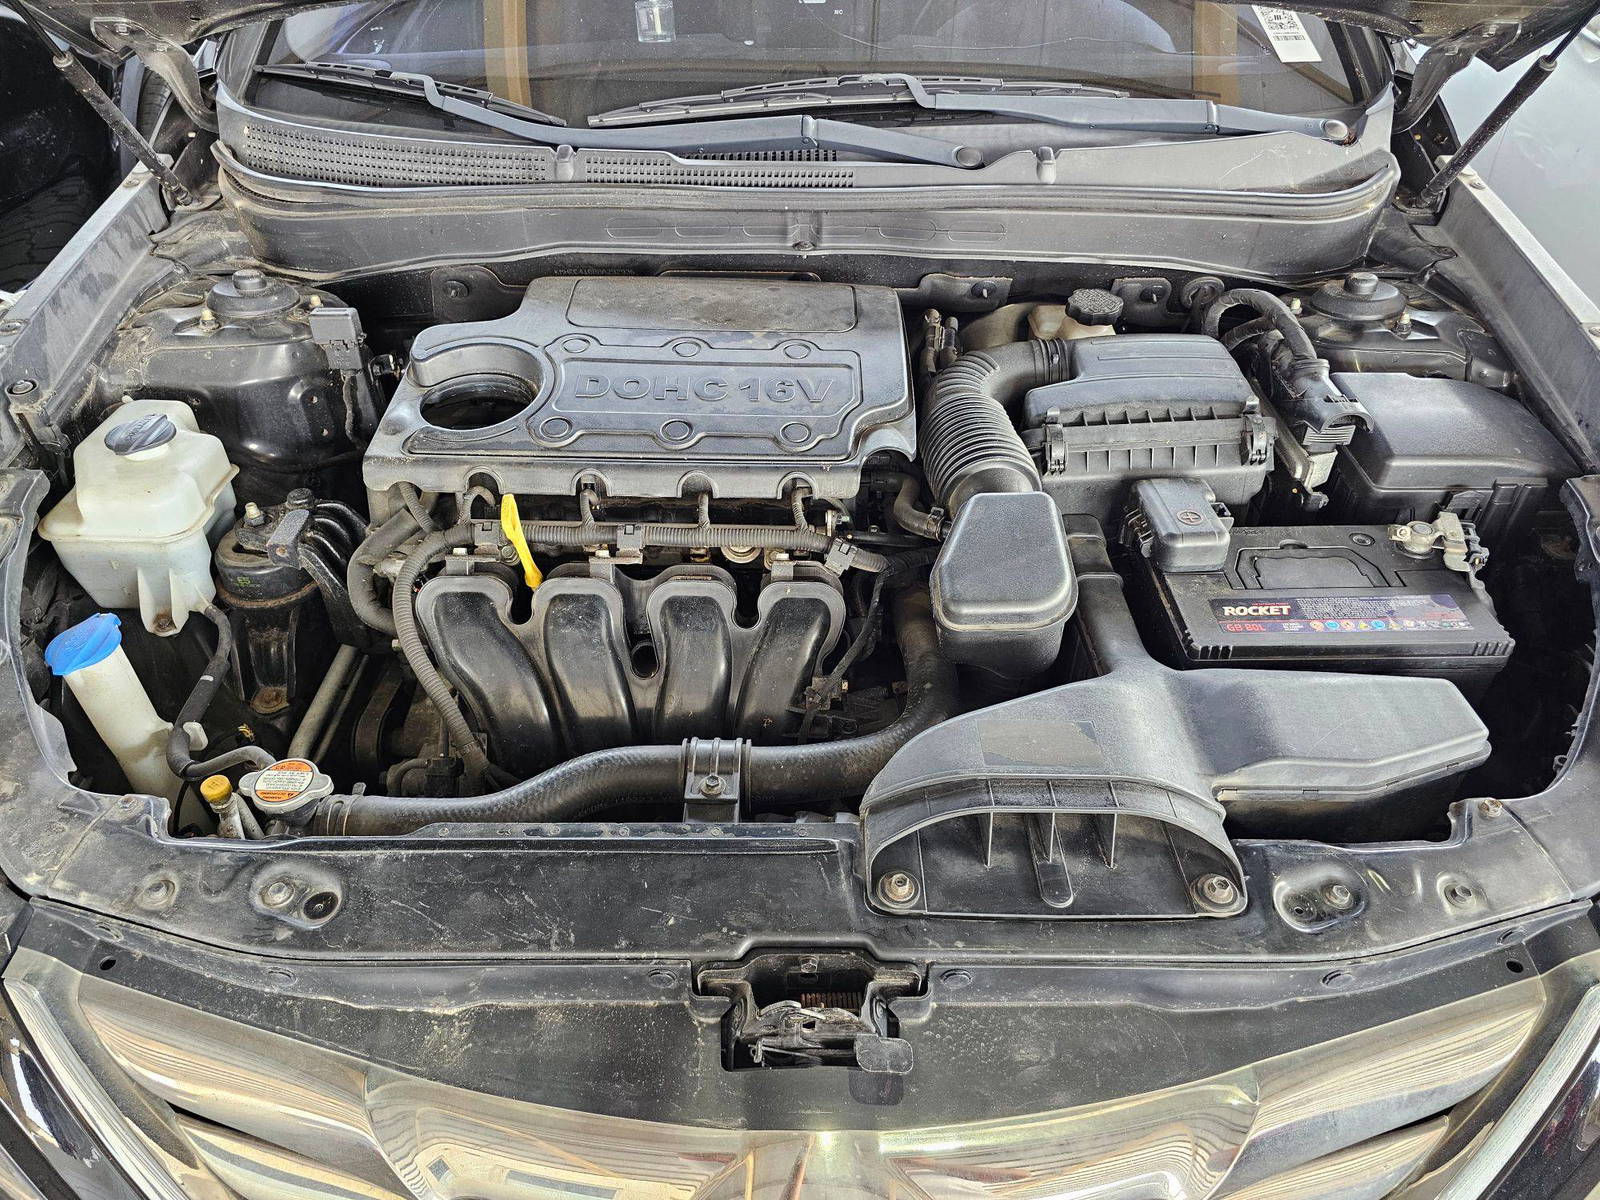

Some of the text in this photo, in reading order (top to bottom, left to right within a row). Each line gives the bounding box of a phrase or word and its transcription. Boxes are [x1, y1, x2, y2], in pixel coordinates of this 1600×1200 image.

[575, 374, 834, 403] DOHC 16V
[1222, 605, 1291, 616] ROCKET
